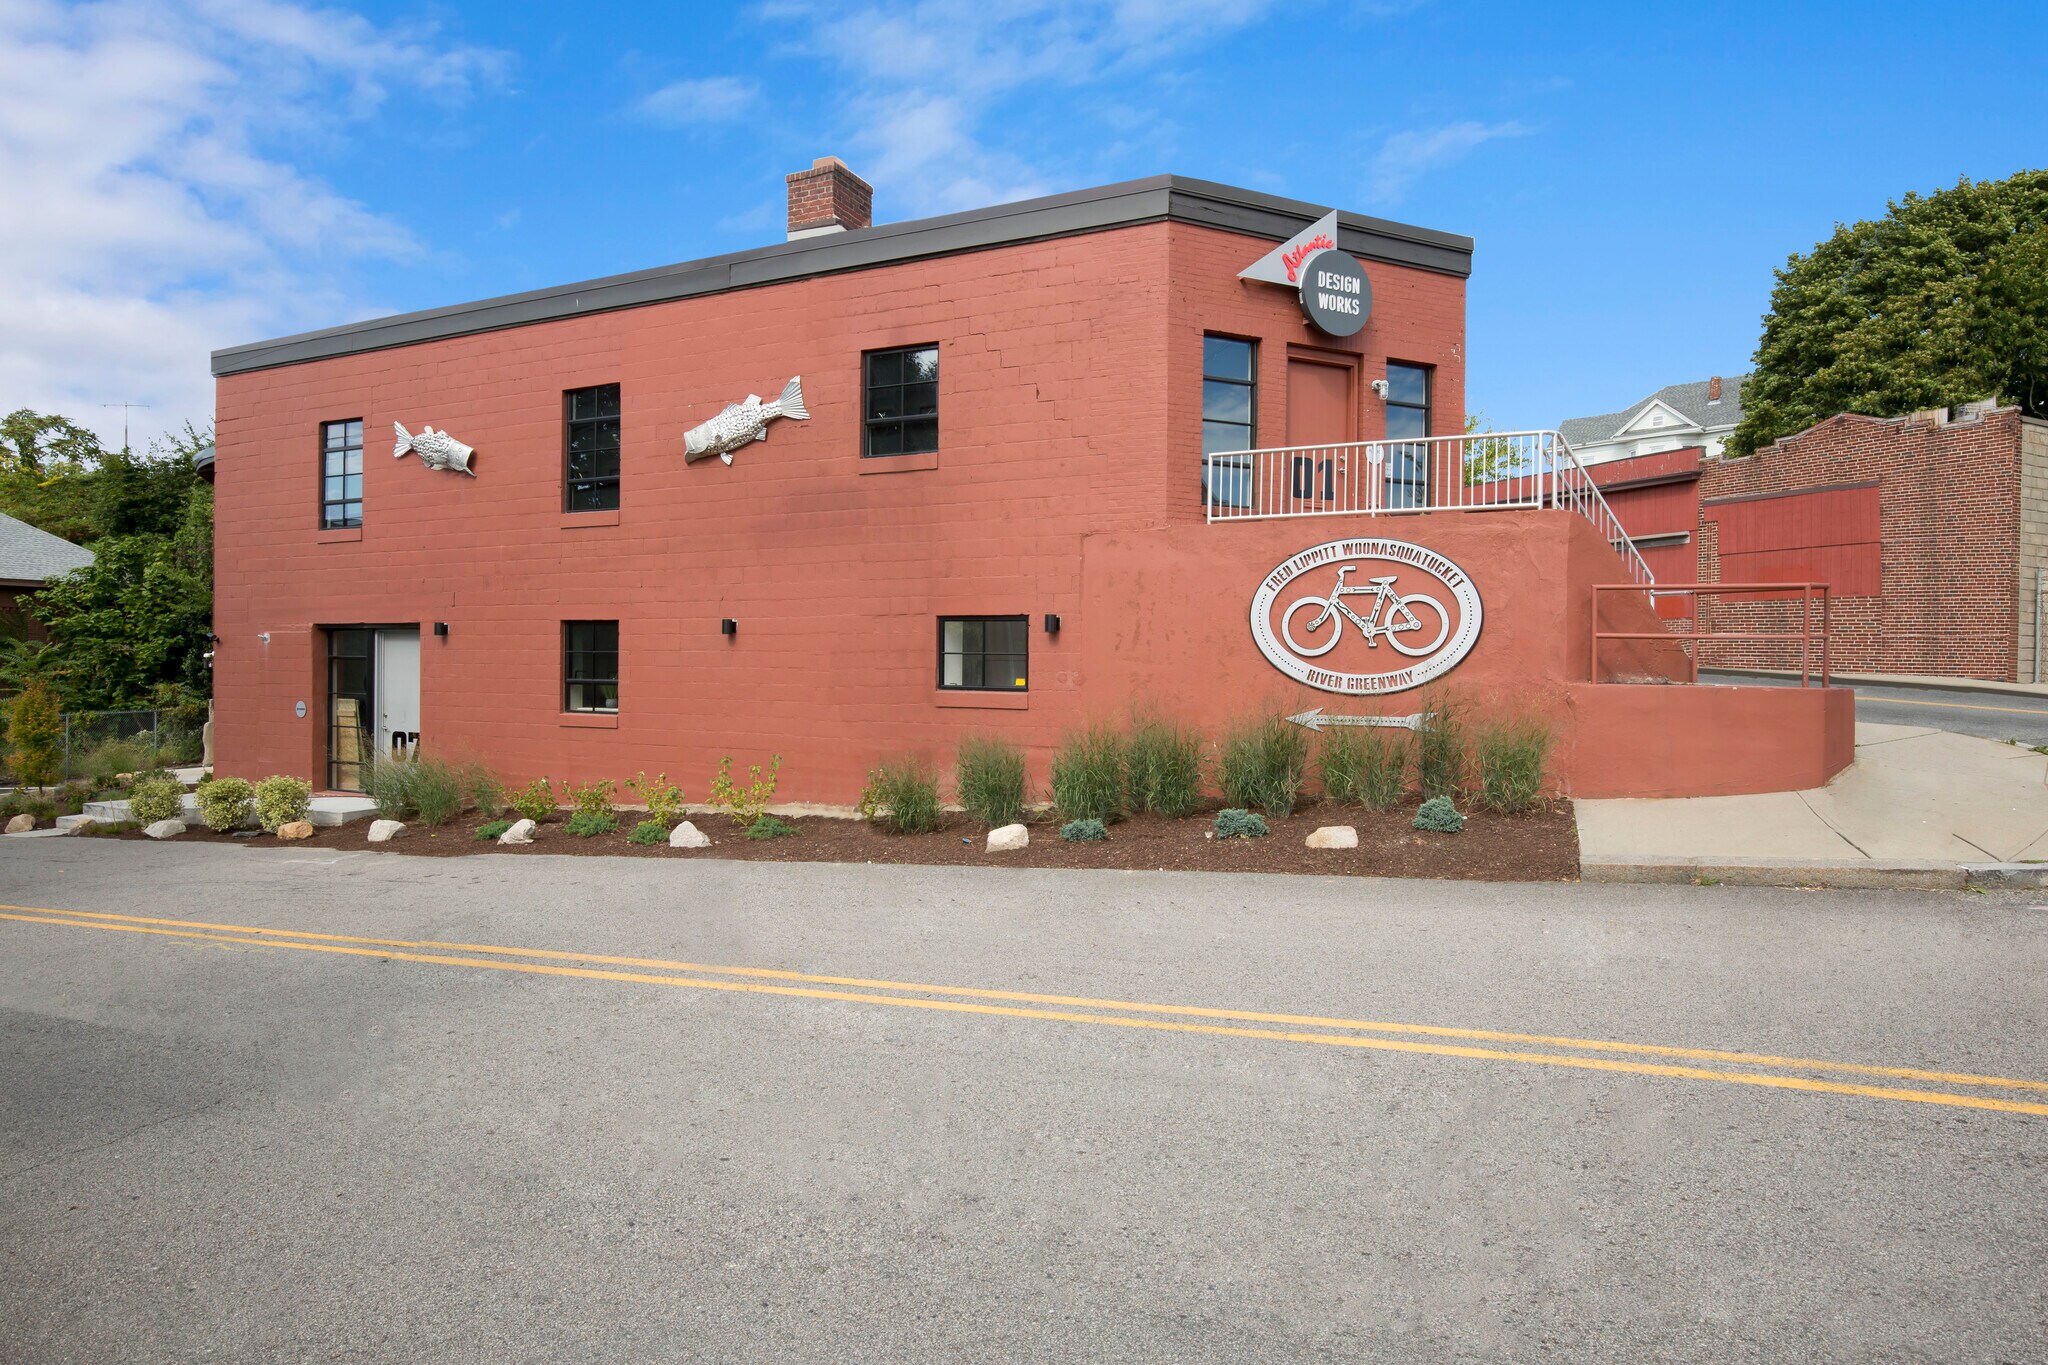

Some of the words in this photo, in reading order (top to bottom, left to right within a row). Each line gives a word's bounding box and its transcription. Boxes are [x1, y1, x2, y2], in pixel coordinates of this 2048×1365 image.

[1282, 233, 1335, 282] Atlantic
[1318, 270, 1360, 294] DESIGN
[1318, 292, 1360, 315] WORKS
[1291, 456, 1334, 500] 01
[1265, 565, 1293, 592] FRED
[1293, 545, 1337, 571] LIPPITT
[1342, 542, 1465, 588] WOONASQUATUCKET
[1306, 668, 1343, 689] RIVER
[1346, 670, 1414, 690] GREENWAY
[391, 731, 420, 763] 07
